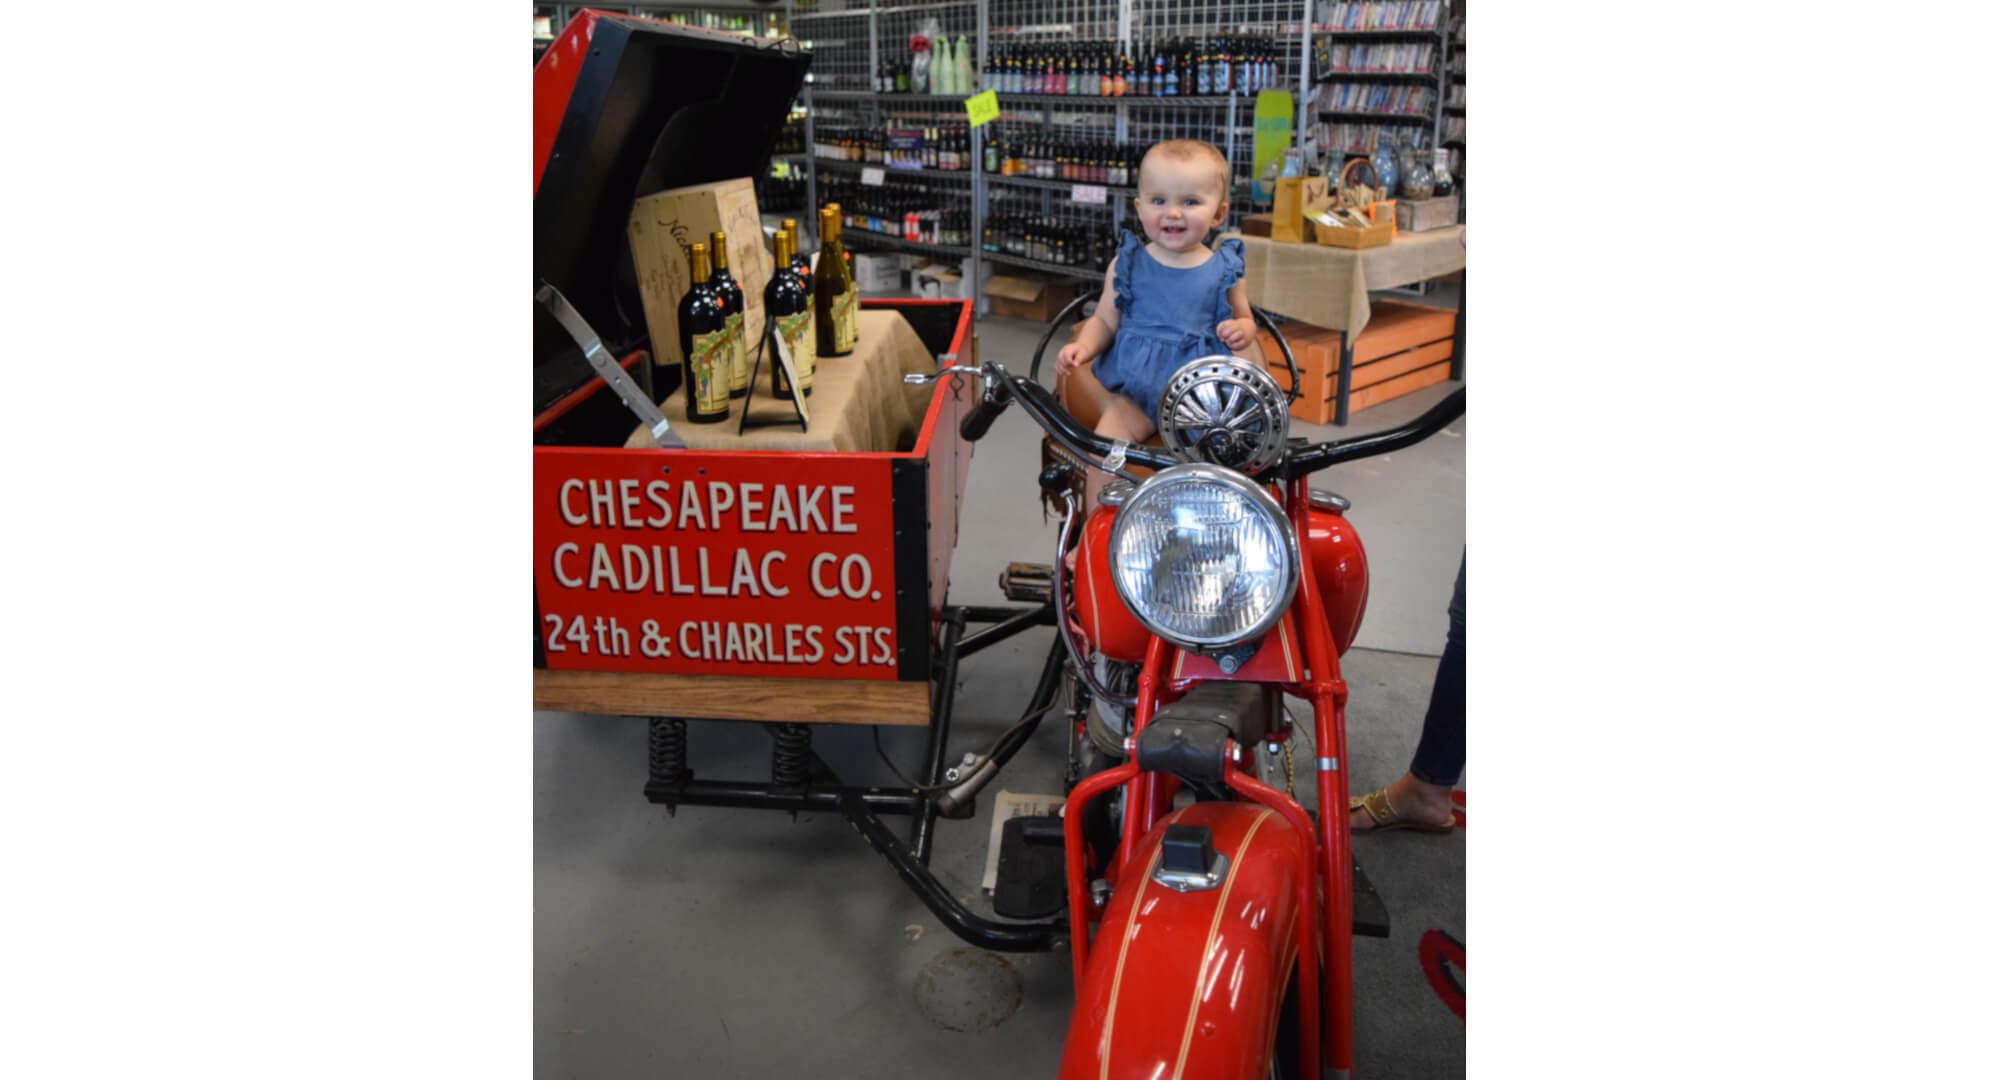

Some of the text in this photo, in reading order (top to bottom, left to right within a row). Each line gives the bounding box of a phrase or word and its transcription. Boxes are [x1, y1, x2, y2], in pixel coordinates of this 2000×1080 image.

[559, 478, 858, 533] CHESAPEAKE
[553, 542, 881, 601] CADILLAC CO.
[544, 613, 896, 667] 24th & CHARLES STS.
